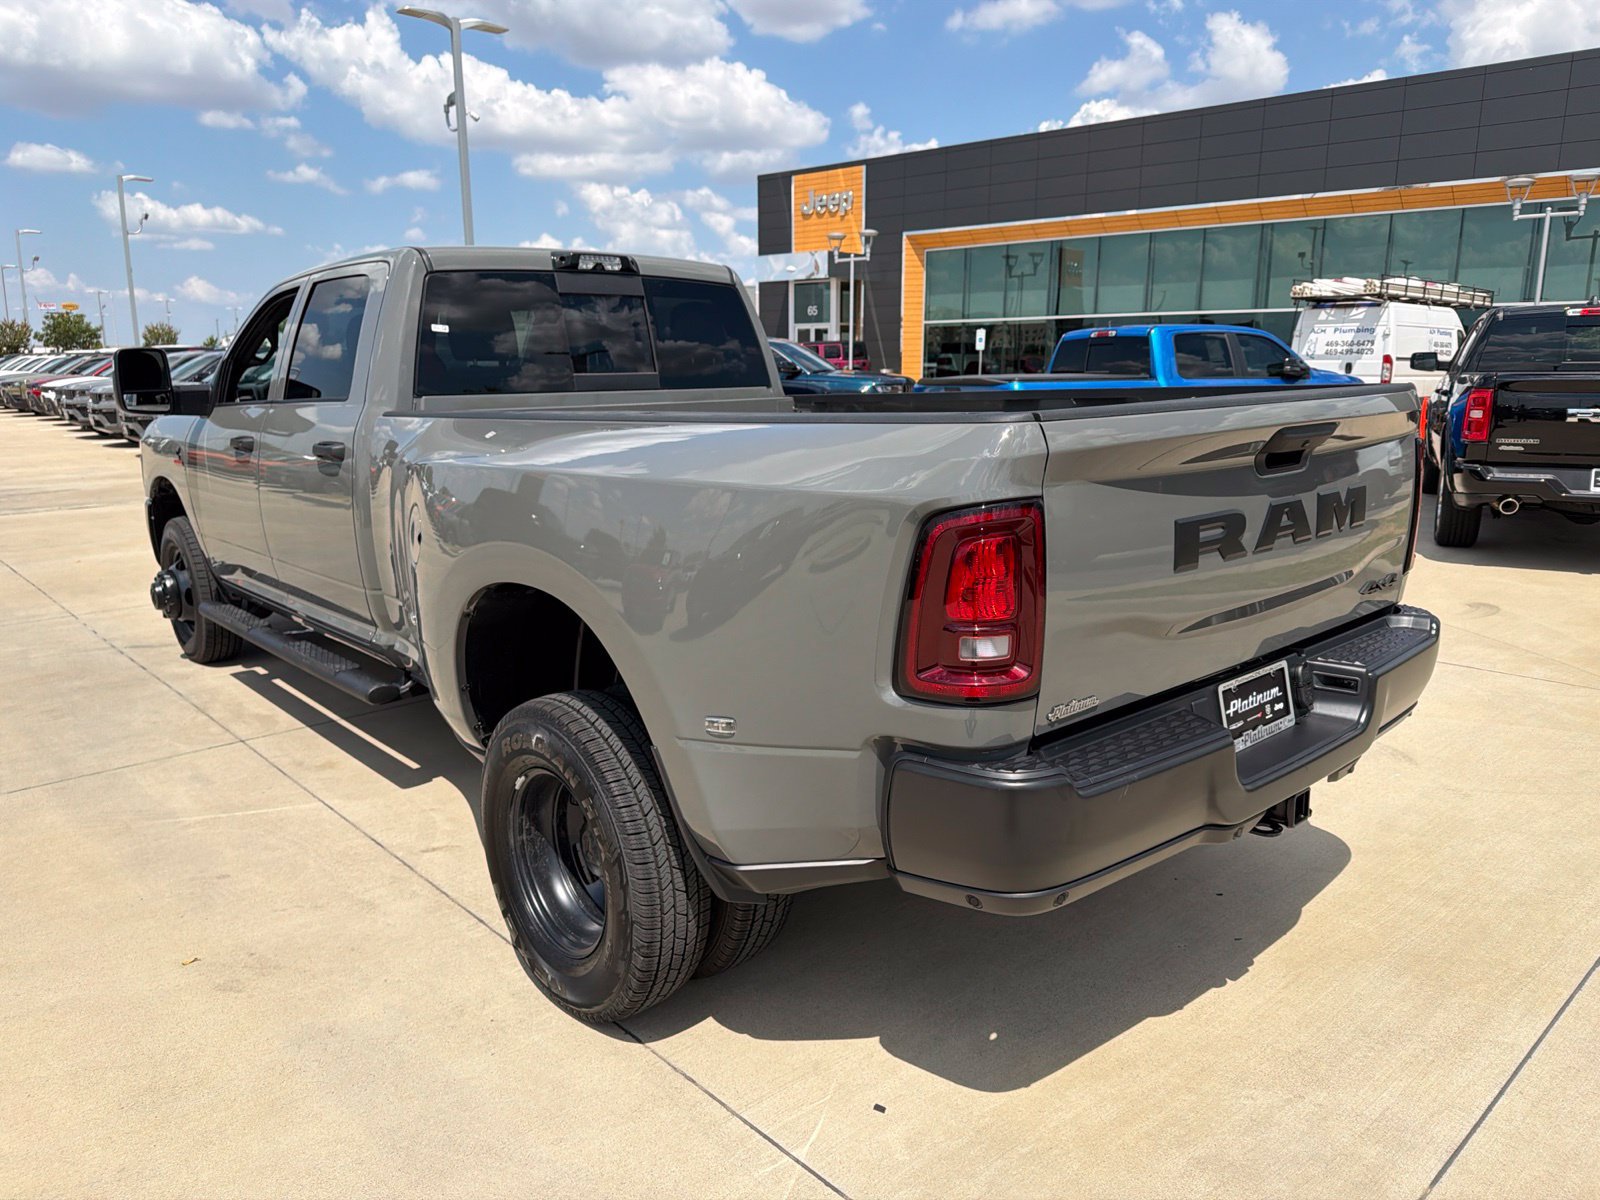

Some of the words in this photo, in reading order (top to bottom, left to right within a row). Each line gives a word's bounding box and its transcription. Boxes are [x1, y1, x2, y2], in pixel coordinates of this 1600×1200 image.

[801, 189, 854, 217] Jeep
[807, 305, 818, 316] 65
[1333, 326, 1376, 335] Plumbing
[1173, 484, 1367, 575] RAM
[1047, 695, 1100, 722] Platinum
[1225, 686, 1283, 717] Platinum
